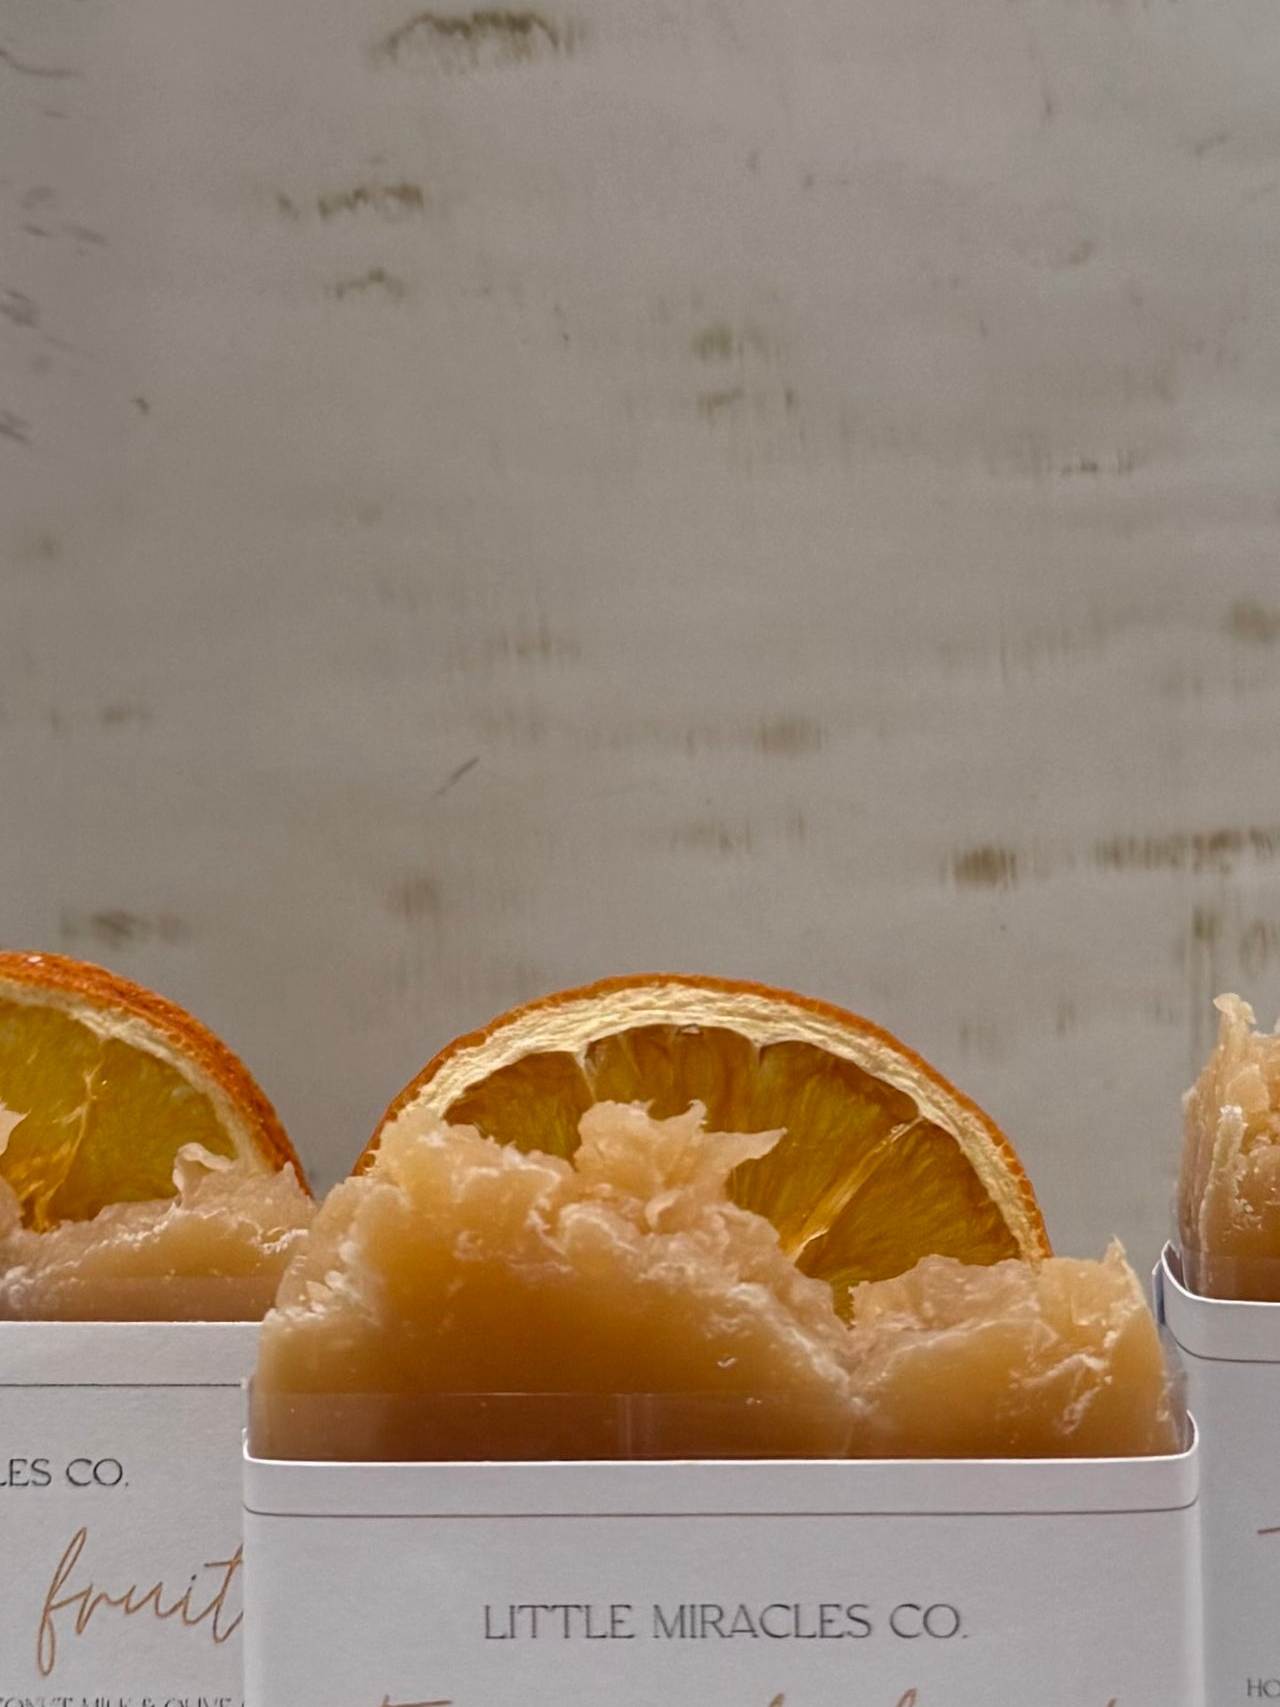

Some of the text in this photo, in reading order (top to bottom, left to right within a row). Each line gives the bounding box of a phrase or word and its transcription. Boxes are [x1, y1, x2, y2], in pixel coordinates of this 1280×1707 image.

[64, 1457, 130, 1488] CO.
[37, 1527, 243, 1678] fruit
[483, 1602, 969, 1641] LITTLE MIRACLES CO.
